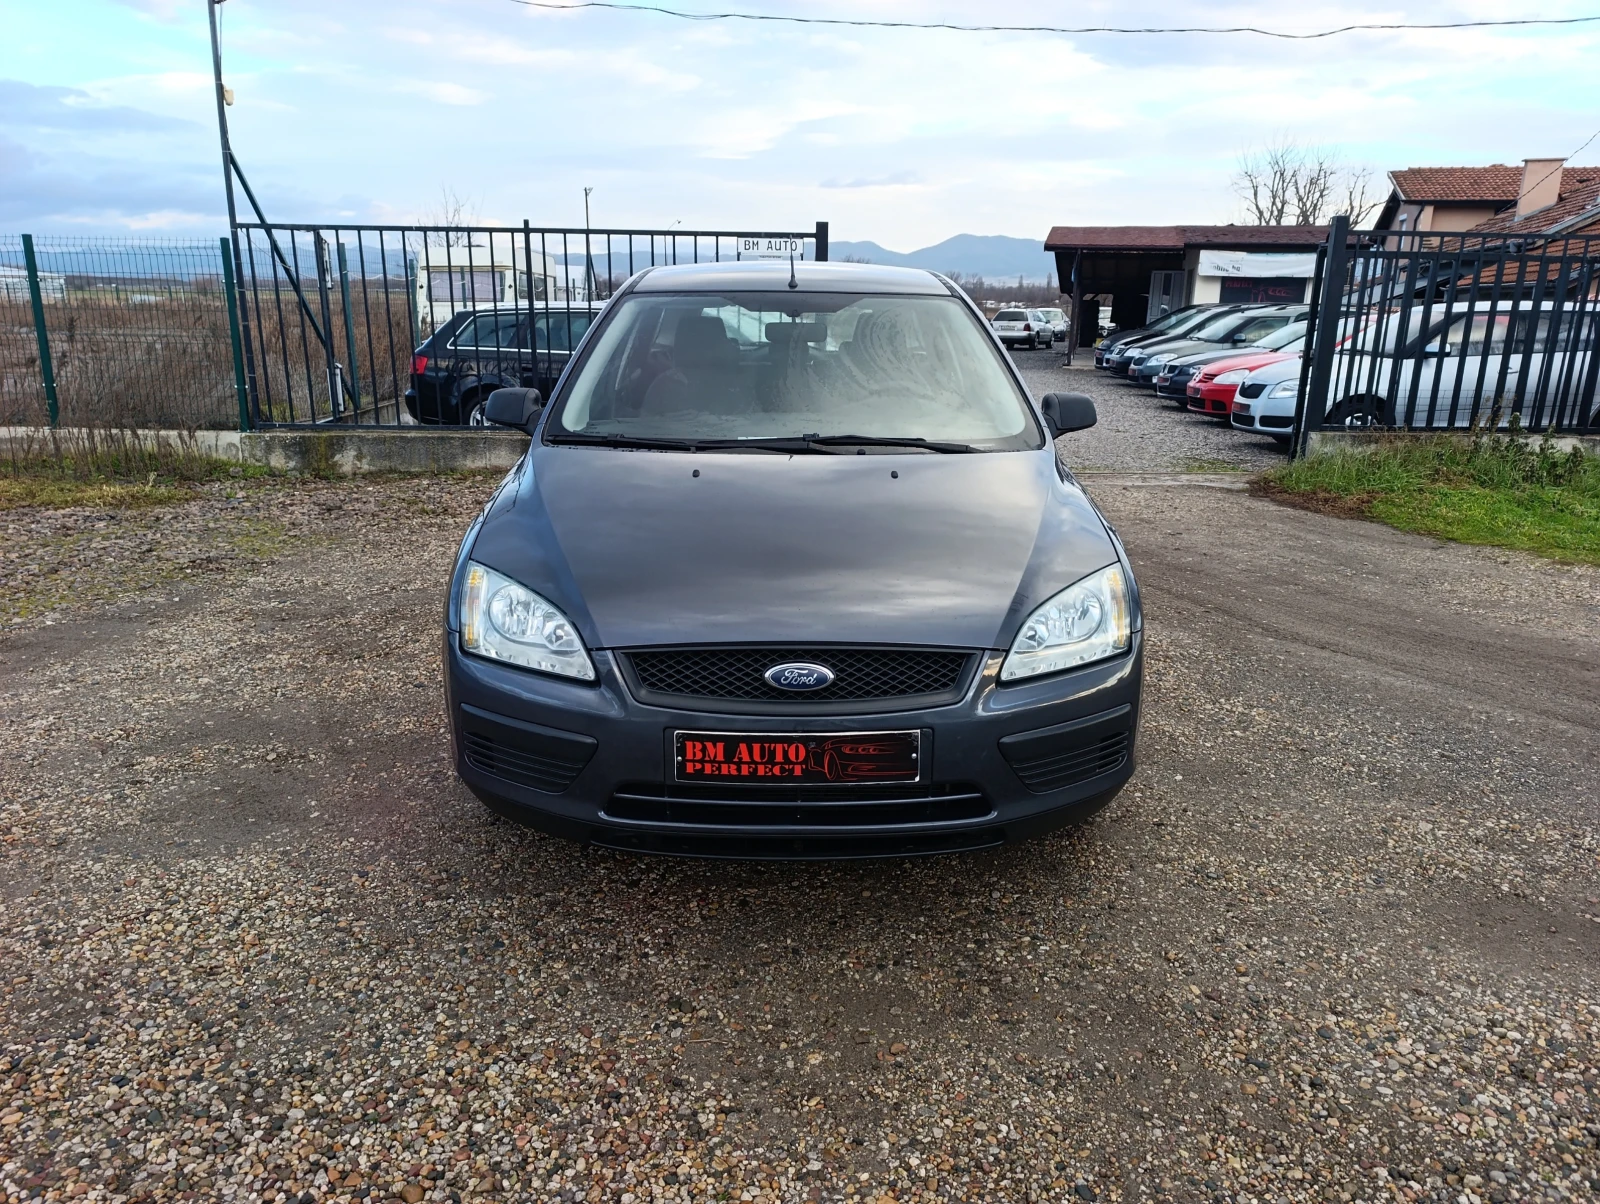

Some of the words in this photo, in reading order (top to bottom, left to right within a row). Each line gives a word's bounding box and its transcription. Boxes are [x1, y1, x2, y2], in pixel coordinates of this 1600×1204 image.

[744, 240, 759, 251] BM
[766, 241, 798, 252] AUTO
[780, 667, 818, 686] Ford
[685, 741, 724, 761] BM
[733, 742, 806, 763] AUTO
[685, 763, 806, 776] PERFECT
